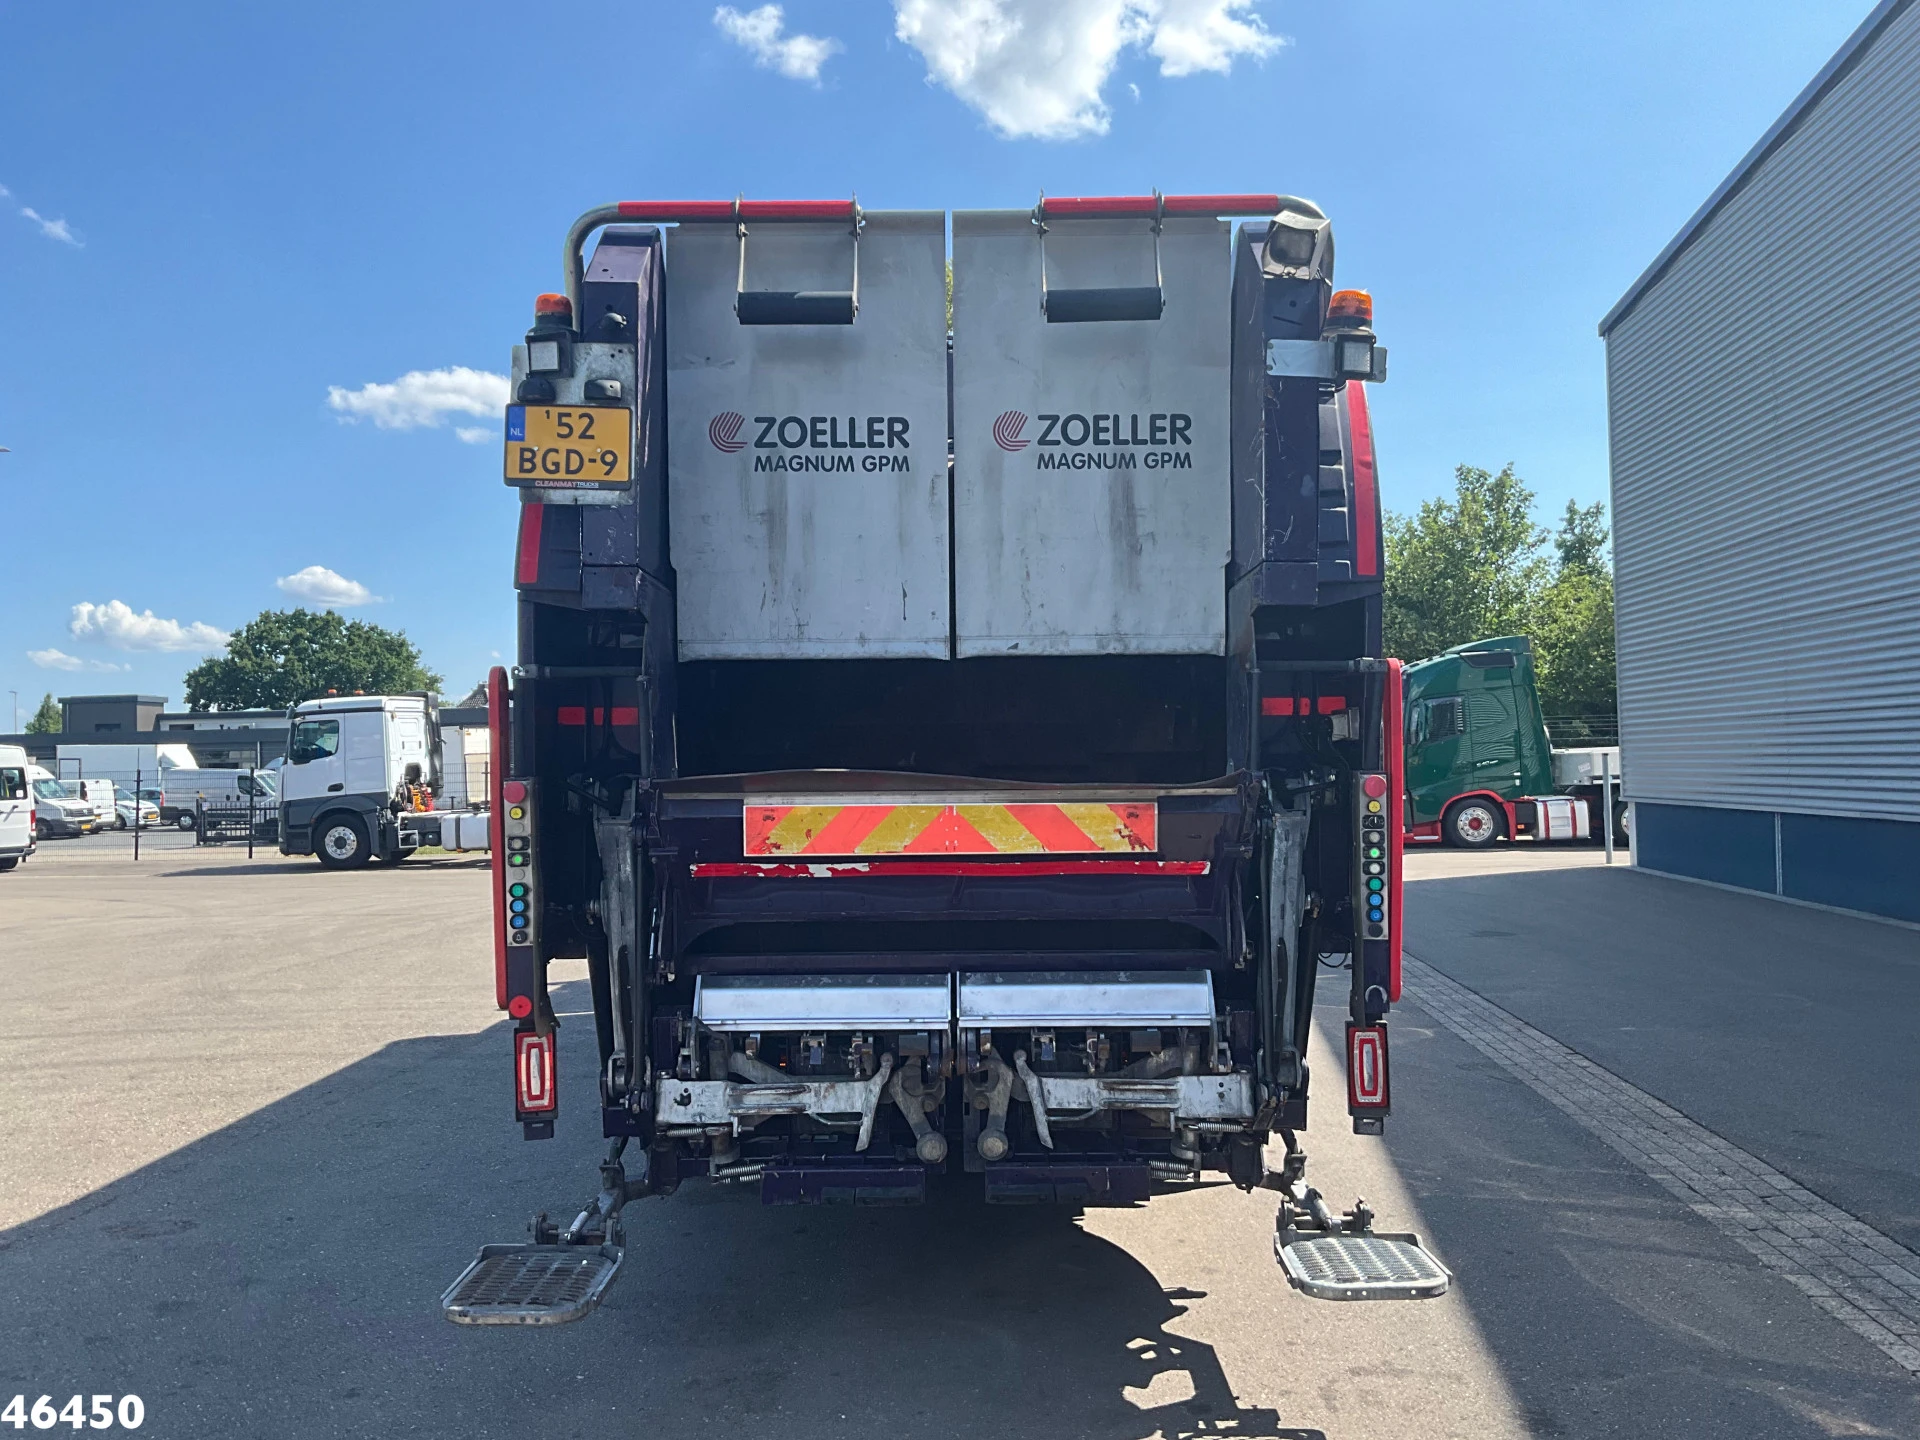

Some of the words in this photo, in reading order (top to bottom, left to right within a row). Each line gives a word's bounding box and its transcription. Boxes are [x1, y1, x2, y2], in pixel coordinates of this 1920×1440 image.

[510, 427, 523, 436] NL
[753, 416, 910, 449] ZOELLER
[1036, 413, 1192, 446] ZOELLER
[518, 447, 619, 476] BGD-9
[753, 454, 855, 473] MAGNUM
[861, 454, 910, 473] GPM
[1036, 452, 1137, 470] MAGNUM
[1143, 451, 1192, 469] GPM
